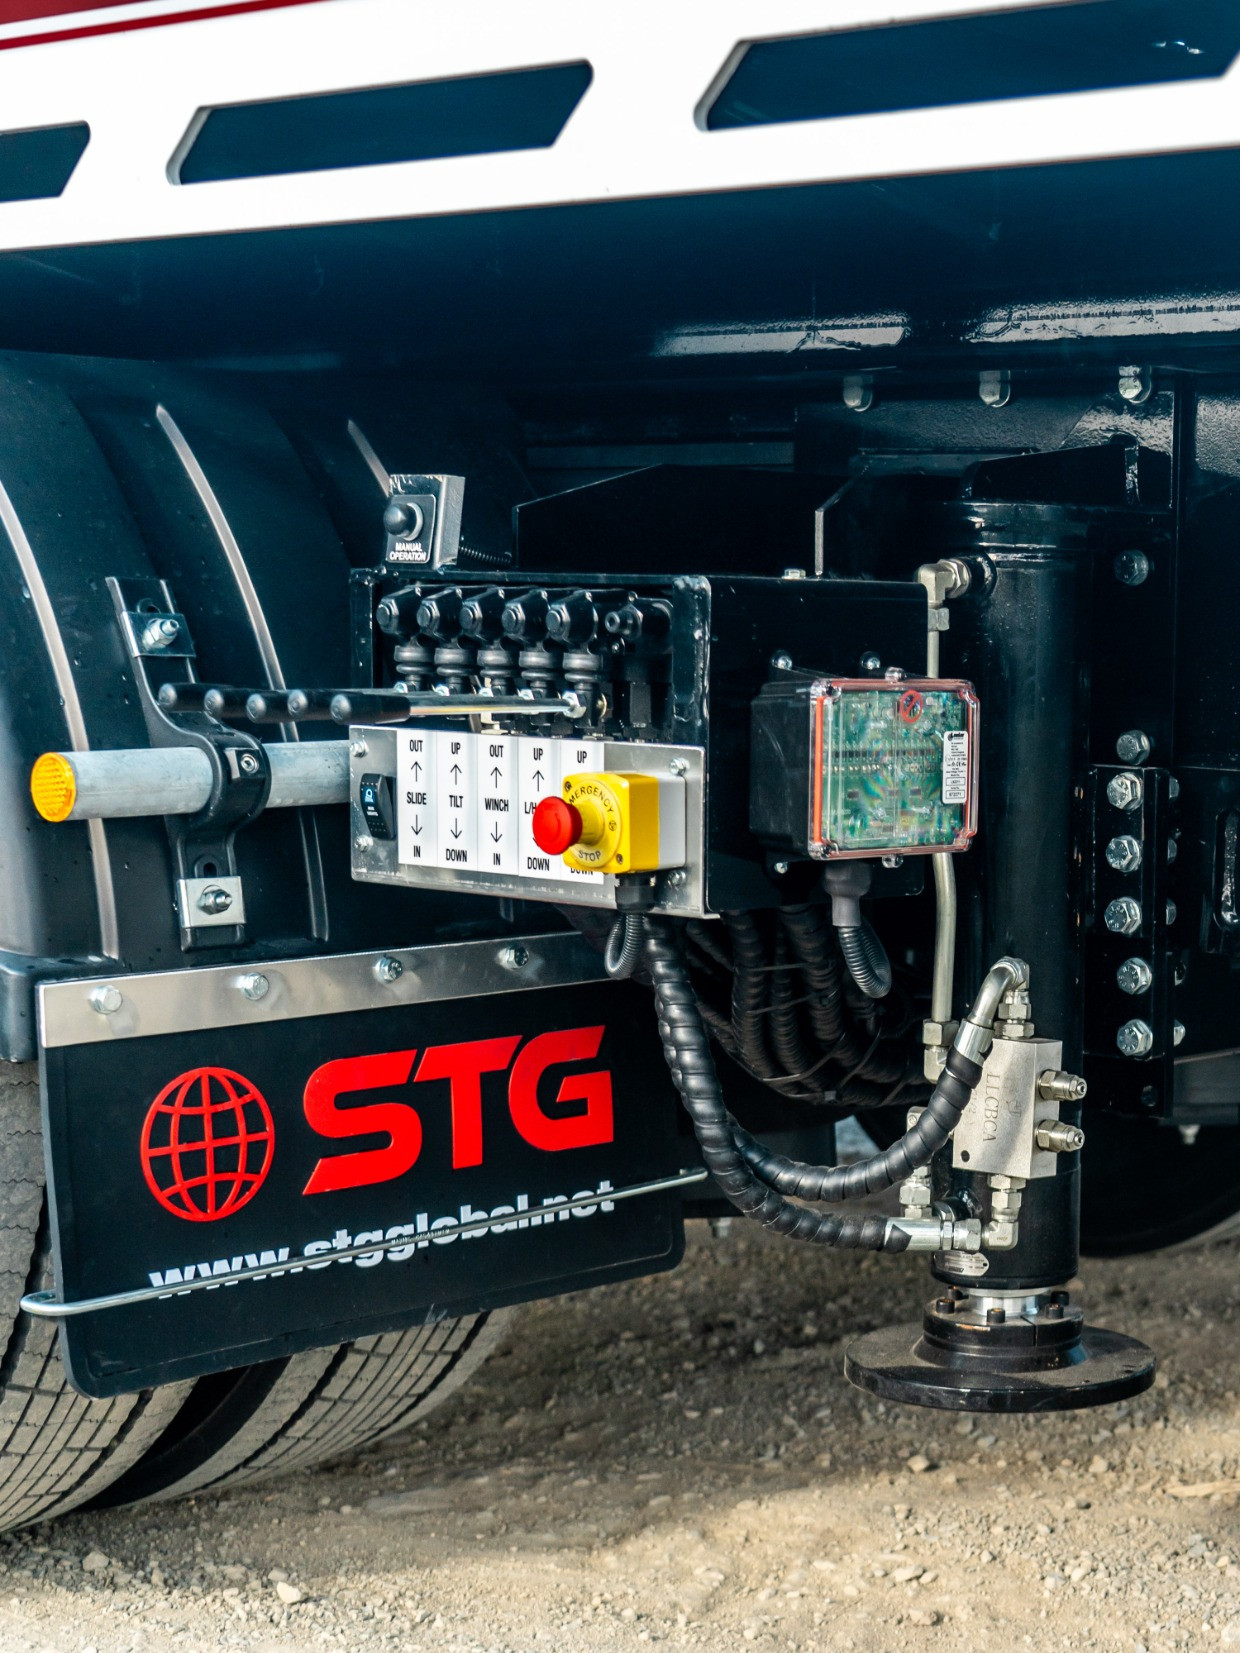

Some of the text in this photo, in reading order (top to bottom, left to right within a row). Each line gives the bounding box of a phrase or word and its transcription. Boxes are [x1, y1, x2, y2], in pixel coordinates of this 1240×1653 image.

[395, 542, 423, 552] MANUAL
[389, 551, 427, 562] OPERATION
[409, 739, 424, 753] OUT
[450, 742, 462, 756] UP
[489, 744, 504, 759] OUT
[533, 747, 544, 761] UP
[576, 750, 588, 764] UP
[406, 791, 427, 806] SLIDE
[448, 794, 464, 808] TILT
[484, 797, 510, 812] WINCH
[569, 786, 614, 813] MERGENCY
[413, 845, 422, 858] IN
[444, 847, 468, 863] DOWN
[578, 850, 602, 862] STOP
[493, 853, 502, 866] IN
[527, 856, 550, 871] DOWN
[303, 1025, 614, 1196] STG
[982, 1072, 1000, 1143] LLCBCA
[148, 1180, 615, 1299] www.stgglobal.net
